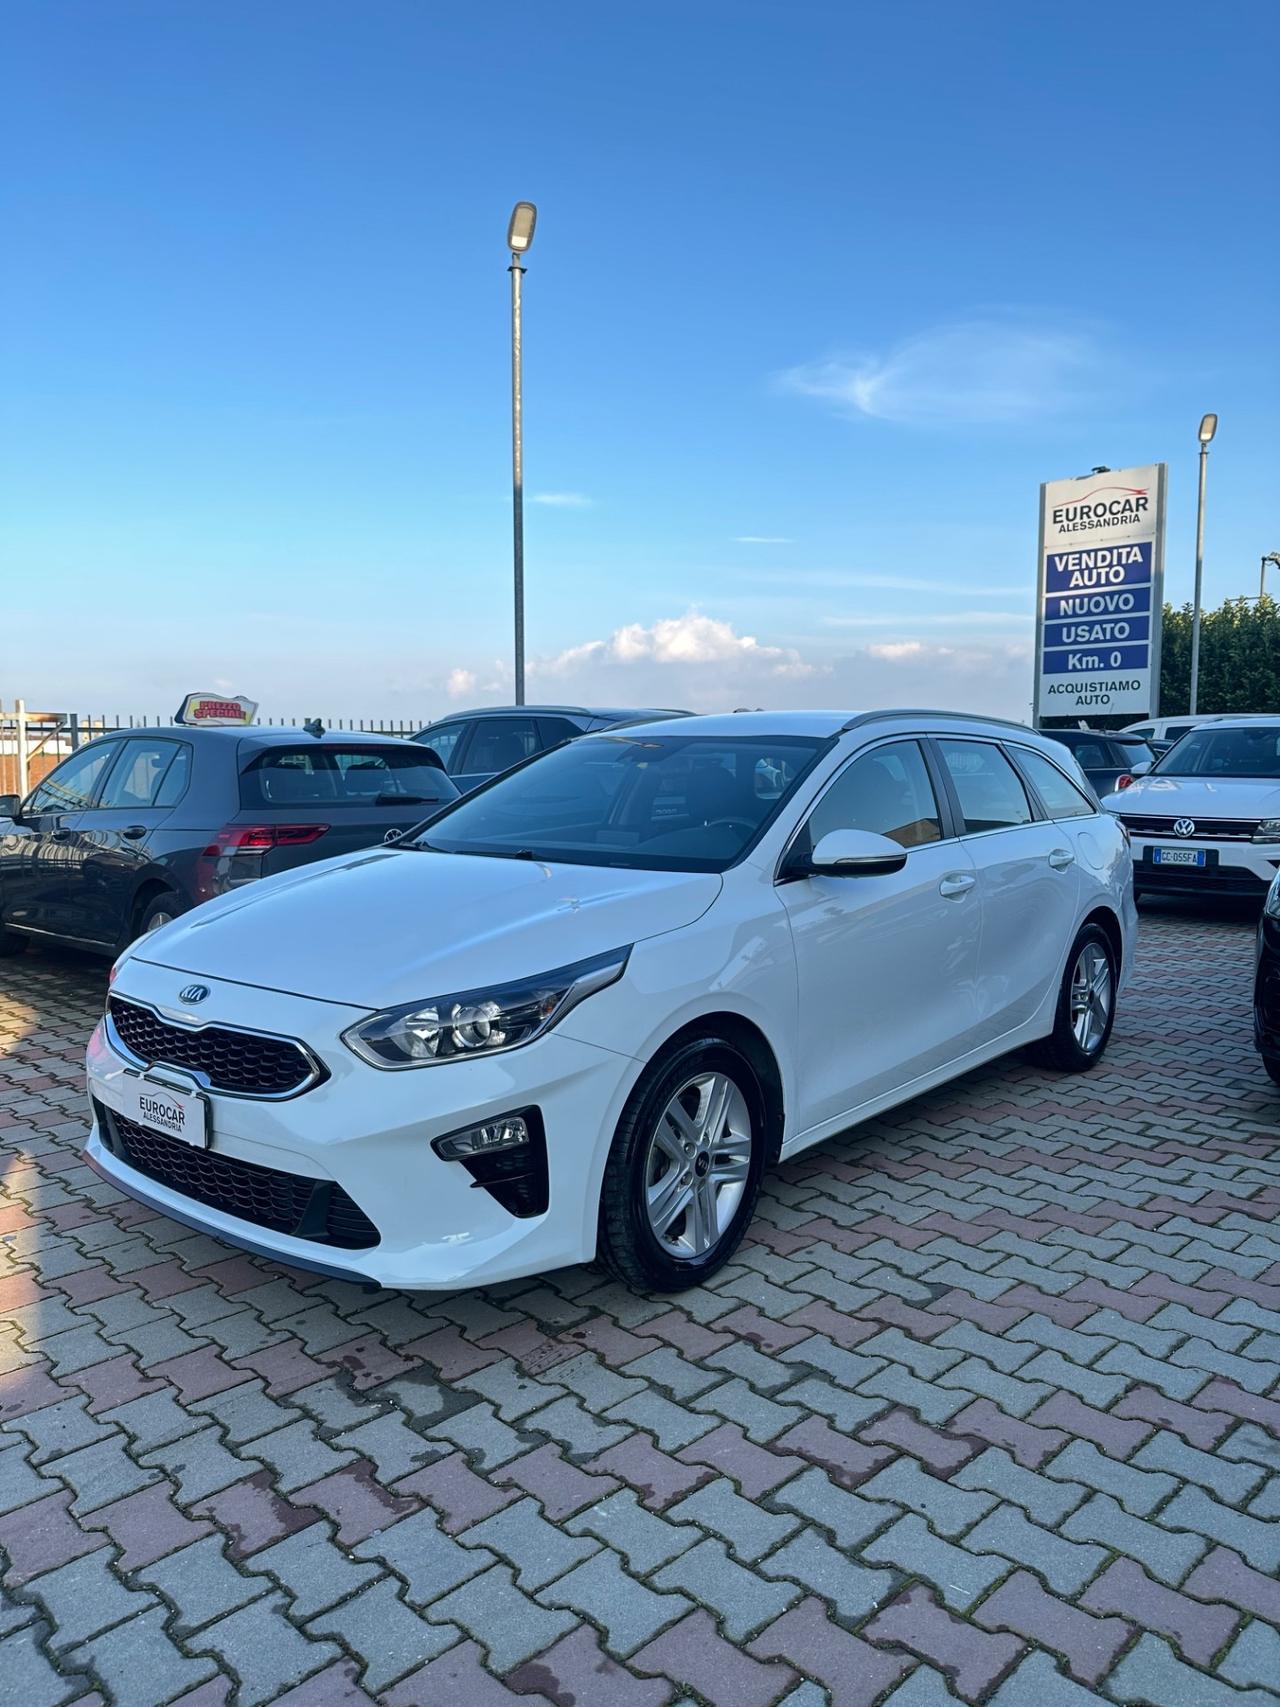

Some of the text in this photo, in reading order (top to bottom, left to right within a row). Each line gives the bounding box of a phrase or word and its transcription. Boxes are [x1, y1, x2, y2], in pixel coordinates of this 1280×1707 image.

[1052, 496, 1148, 525] EUROCAR
[1058, 513, 1141, 533] ALESSANDRIA
[1054, 546, 1143, 573] VENDITA
[1069, 566, 1125, 588] AUTO
[1059, 593, 1135, 616] NUOVO
[1062, 621, 1130, 643] USATO
[1067, 651, 1122, 670] Km. 0
[1047, 679, 1141, 695] ACQUISTIAMO
[1075, 694, 1111, 706] AUTO
[181, 986, 203, 1000] KIA
[139, 1096, 186, 1126] EUROCAR
[142, 1111, 182, 1133] ALESSANDRIA
